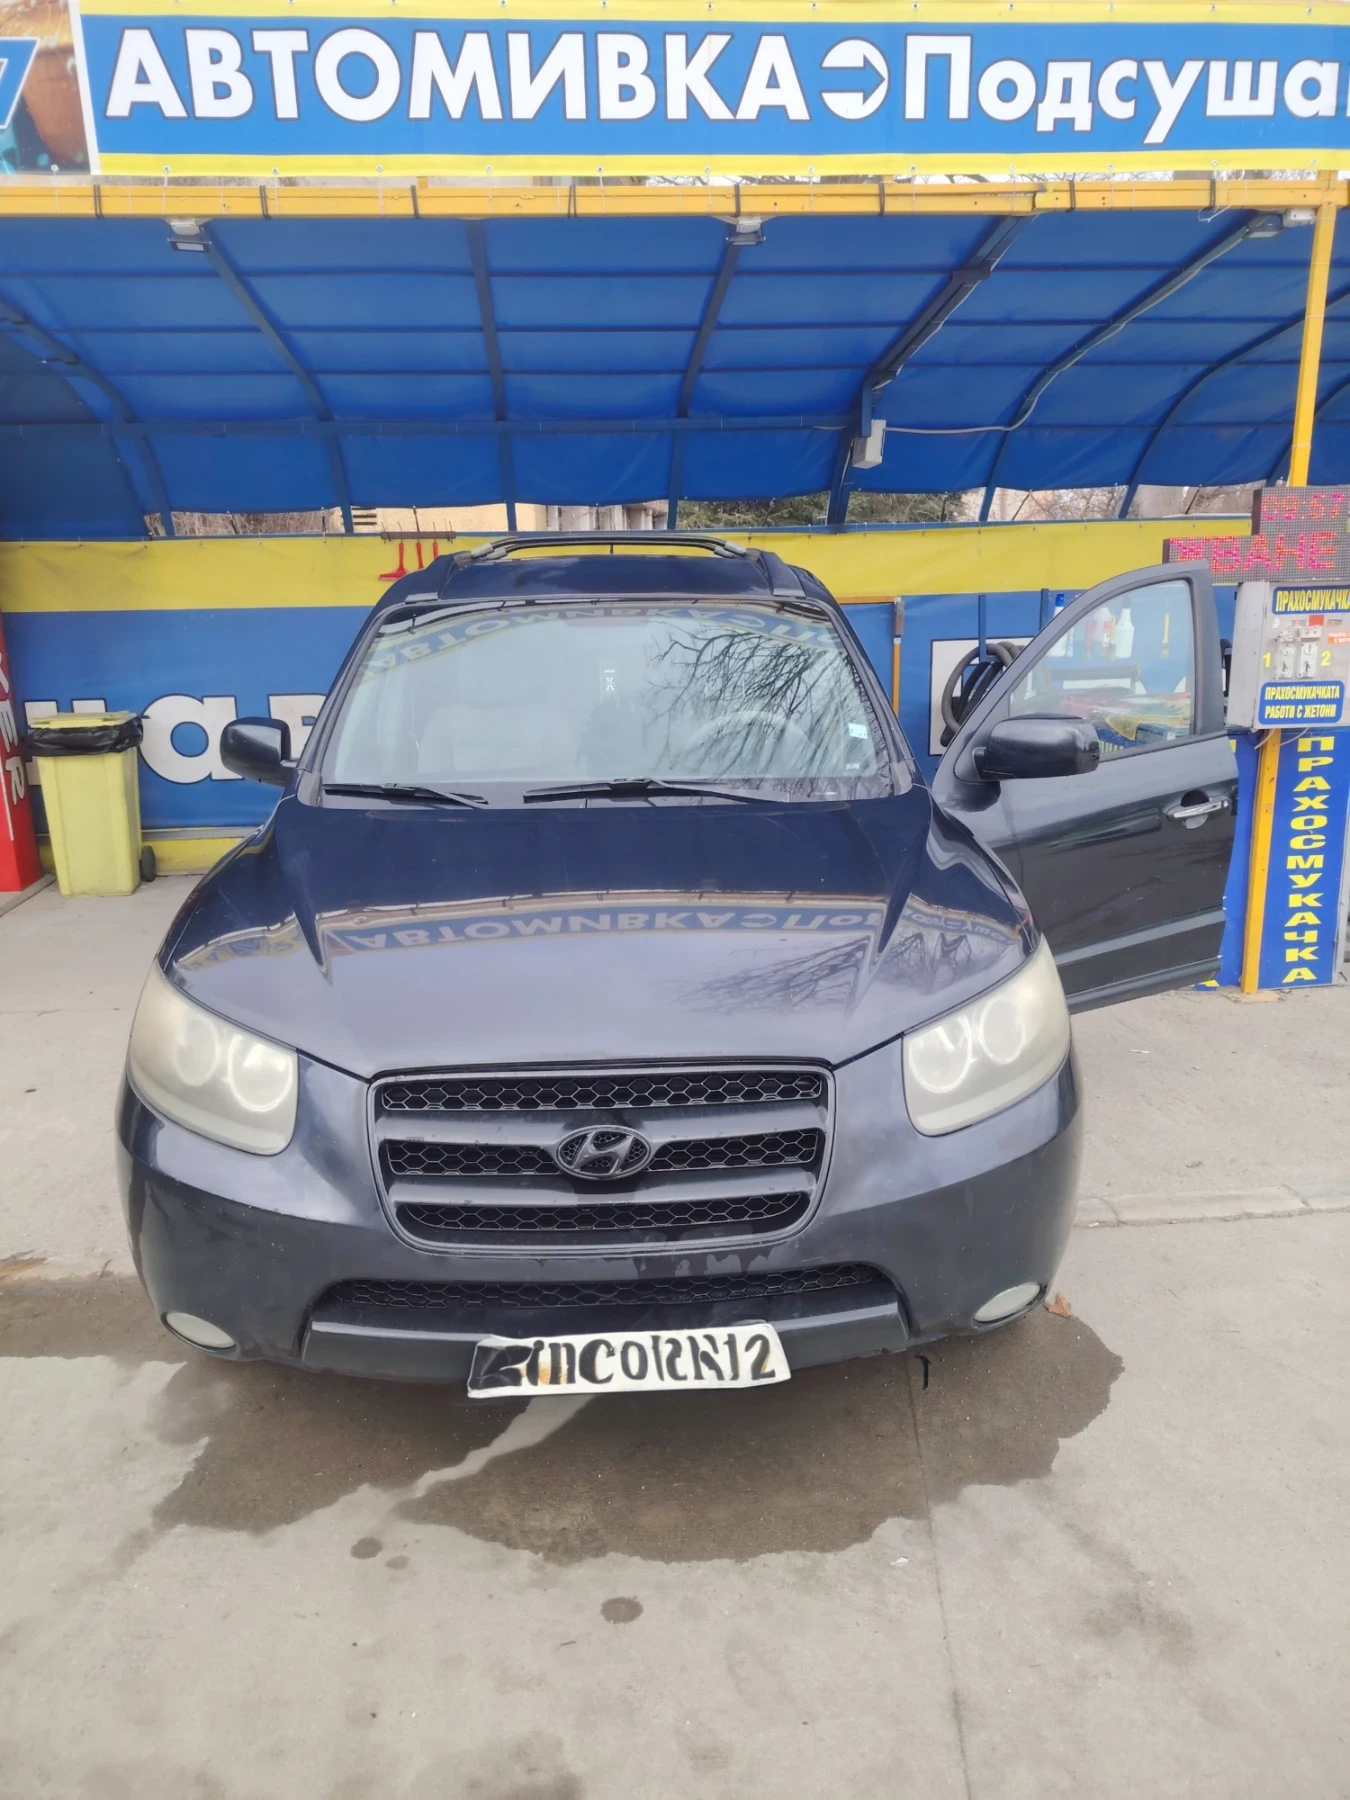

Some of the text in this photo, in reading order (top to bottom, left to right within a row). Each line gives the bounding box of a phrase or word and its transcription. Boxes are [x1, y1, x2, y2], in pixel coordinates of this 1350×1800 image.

[105, 27, 811, 122] АВТОМИВКА
[904, 34, 1350, 145] Подсуша
[1261, 493, 1345, 521] 09:57
[1275, 589, 1350, 612] ПРАХОСМУКАЧК
[1263, 653, 1271, 668] 1
[1321, 650, 1331, 666] 2
[1264, 686, 1340, 700] ПРАХОСМУКАЧКАТА
[1264, 704, 1337, 719] РАБОТИ С ЖЕТОНИ
[1282, 736, 1335, 984] ПРАХОСМУКАЧКА
